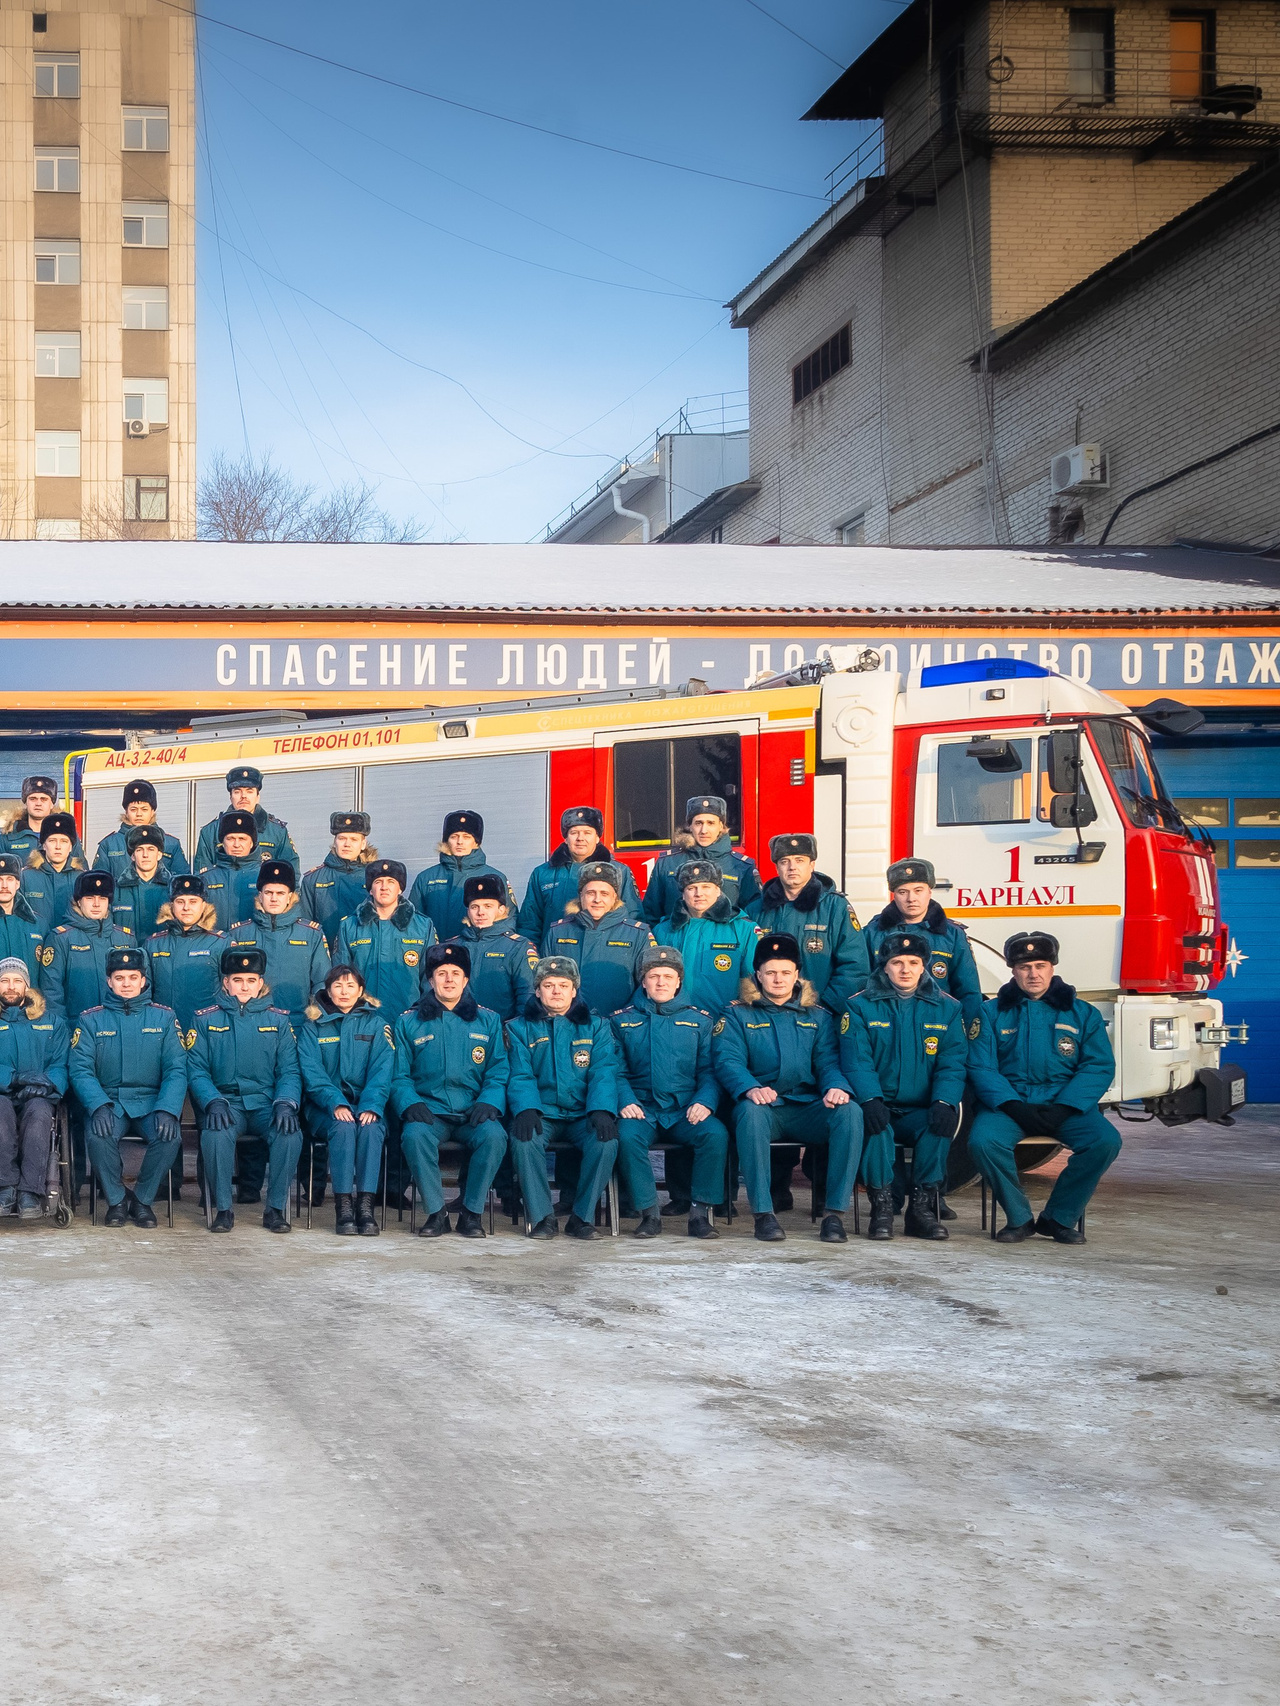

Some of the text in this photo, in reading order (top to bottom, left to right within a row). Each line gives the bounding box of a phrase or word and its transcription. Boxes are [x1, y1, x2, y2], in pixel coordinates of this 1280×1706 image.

[216, 644, 467, 686] СПАСЕНИЕ
[497, 637, 671, 690] ЛЮДЕЙ
[1121, 642, 1280, 685] ОТВАЖ
[273, 728, 401, 754] ТЕЛЕФОН 01,101
[105, 746, 187, 768] АЦ-3,2-40/4
[1004, 845, 1024, 883] 1
[1036, 856, 1076, 864] 43265
[956, 885, 1077, 907] БАРНАУЛ
